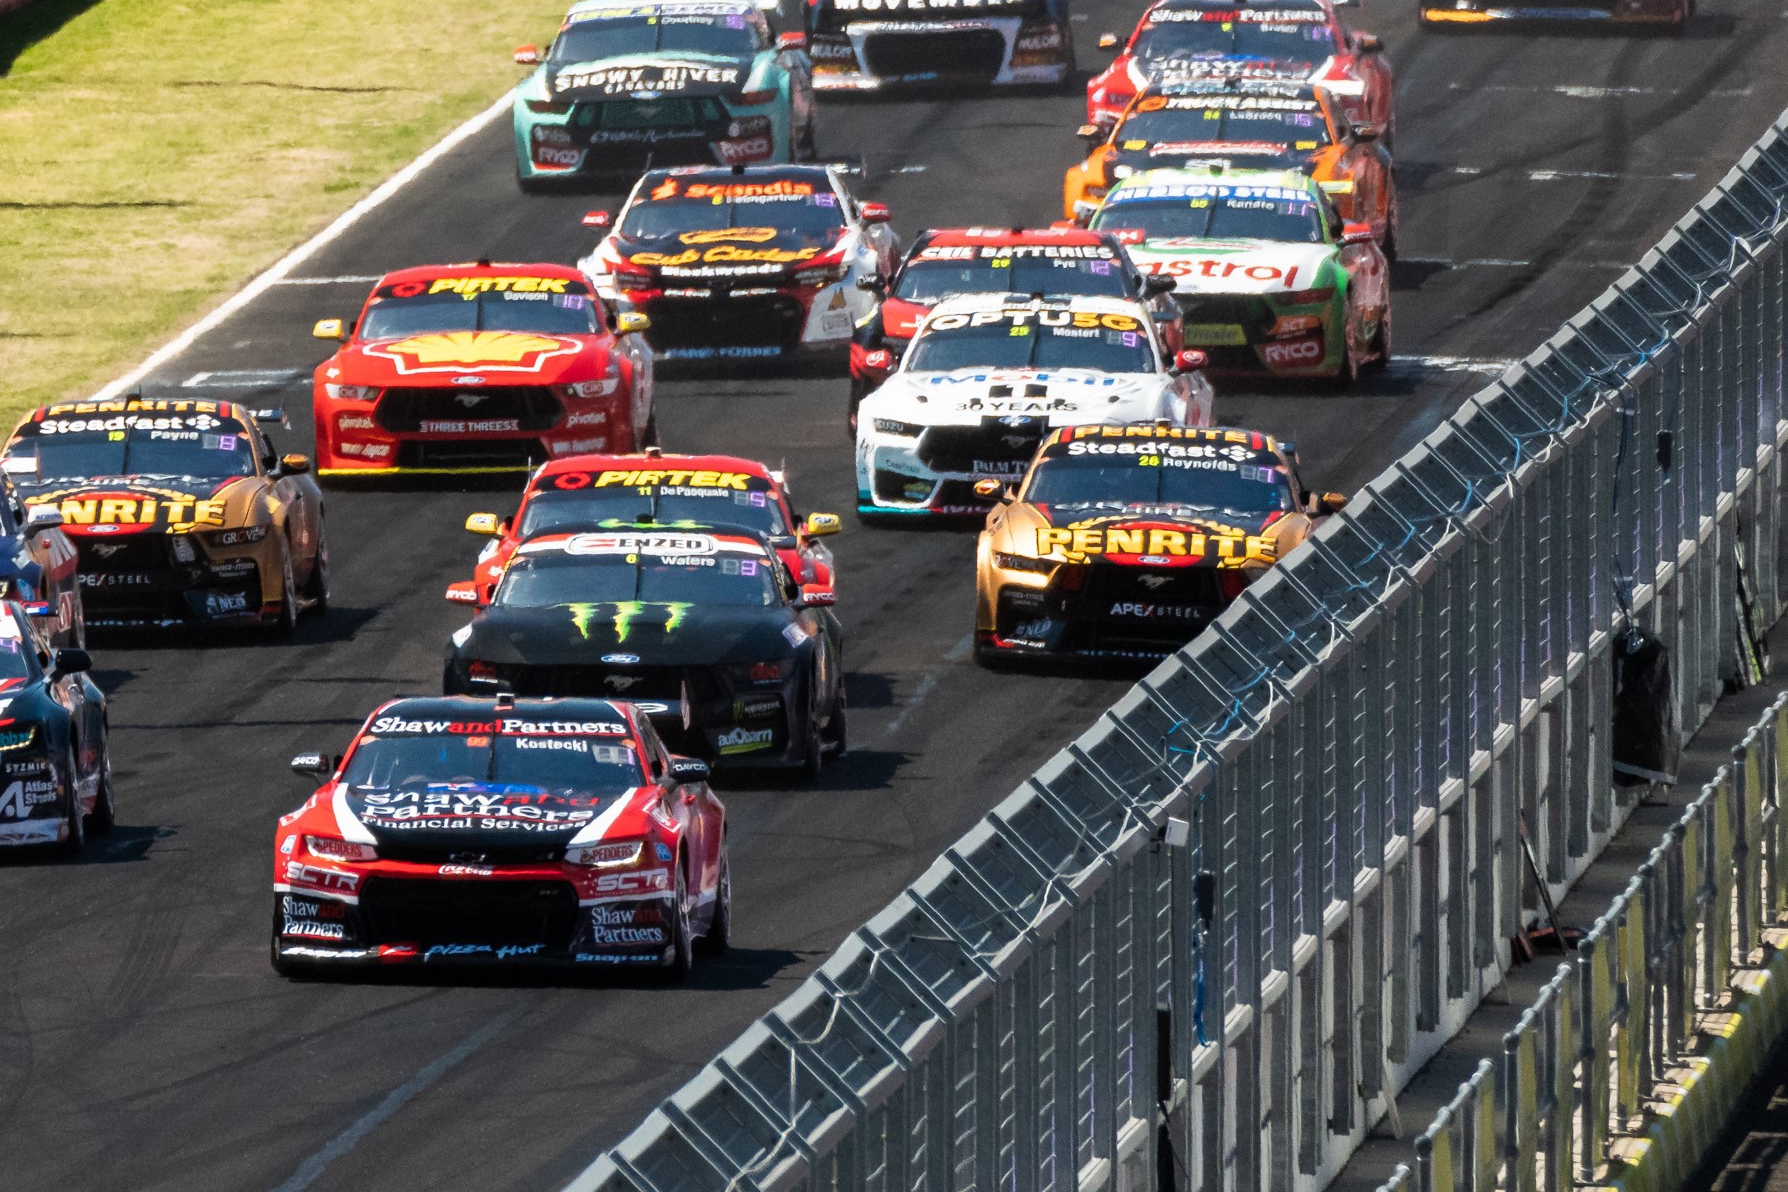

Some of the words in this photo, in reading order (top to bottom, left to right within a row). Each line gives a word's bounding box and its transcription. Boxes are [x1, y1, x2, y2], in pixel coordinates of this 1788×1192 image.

[554, 66, 644, 93] SNOWY
[663, 66, 739, 84] RIVER
[685, 181, 813, 199] Scandia
[1233, 185, 1312, 201] STEEL
[629, 249, 701, 266] Cub
[703, 245, 821, 263] Cadet
[980, 245, 1114, 259] BATTERIES
[1134, 259, 1299, 289] astrol
[428, 277, 570, 295] PIRTEK
[1052, 327, 1100, 338] Mostert
[1265, 340, 1319, 361] RYCO
[48, 400, 217, 416] PENRITE
[985, 401, 1079, 412] YEARS
[38, 416, 183, 435] Steadfast
[429, 422, 466, 432] THREE
[467, 420, 511, 431] THREES
[149, 430, 199, 442] Payne
[1068, 441, 1216, 459] Steadfast
[1139, 454, 1161, 467] 26
[1163, 456, 1237, 472] Reynolds
[594, 469, 753, 491] PIRTEK
[637, 486, 652, 496] 11
[618, 537, 703, 550] ENZED
[1035, 526, 1279, 565] PENRITE
[625, 554, 637, 565] 6
[661, 555, 716, 567] Waters
[108, 574, 151, 585] STEEL
[1109, 602, 1155, 618] APEX
[1156, 607, 1201, 619] STEEL
[465, 735, 491, 748] 99
[515, 738, 588, 753] Kostecki
[5, 762, 48, 774] SYZMIK
[24, 781, 55, 793] Atlas
[24, 792, 58, 805] Steels
[362, 817, 473, 830] Financial
[480, 819, 588, 833] Services
[286, 860, 360, 891] SCTR
[596, 868, 669, 892] SCTR
[282, 914, 344, 939] Partners
[592, 925, 663, 944] Partners
